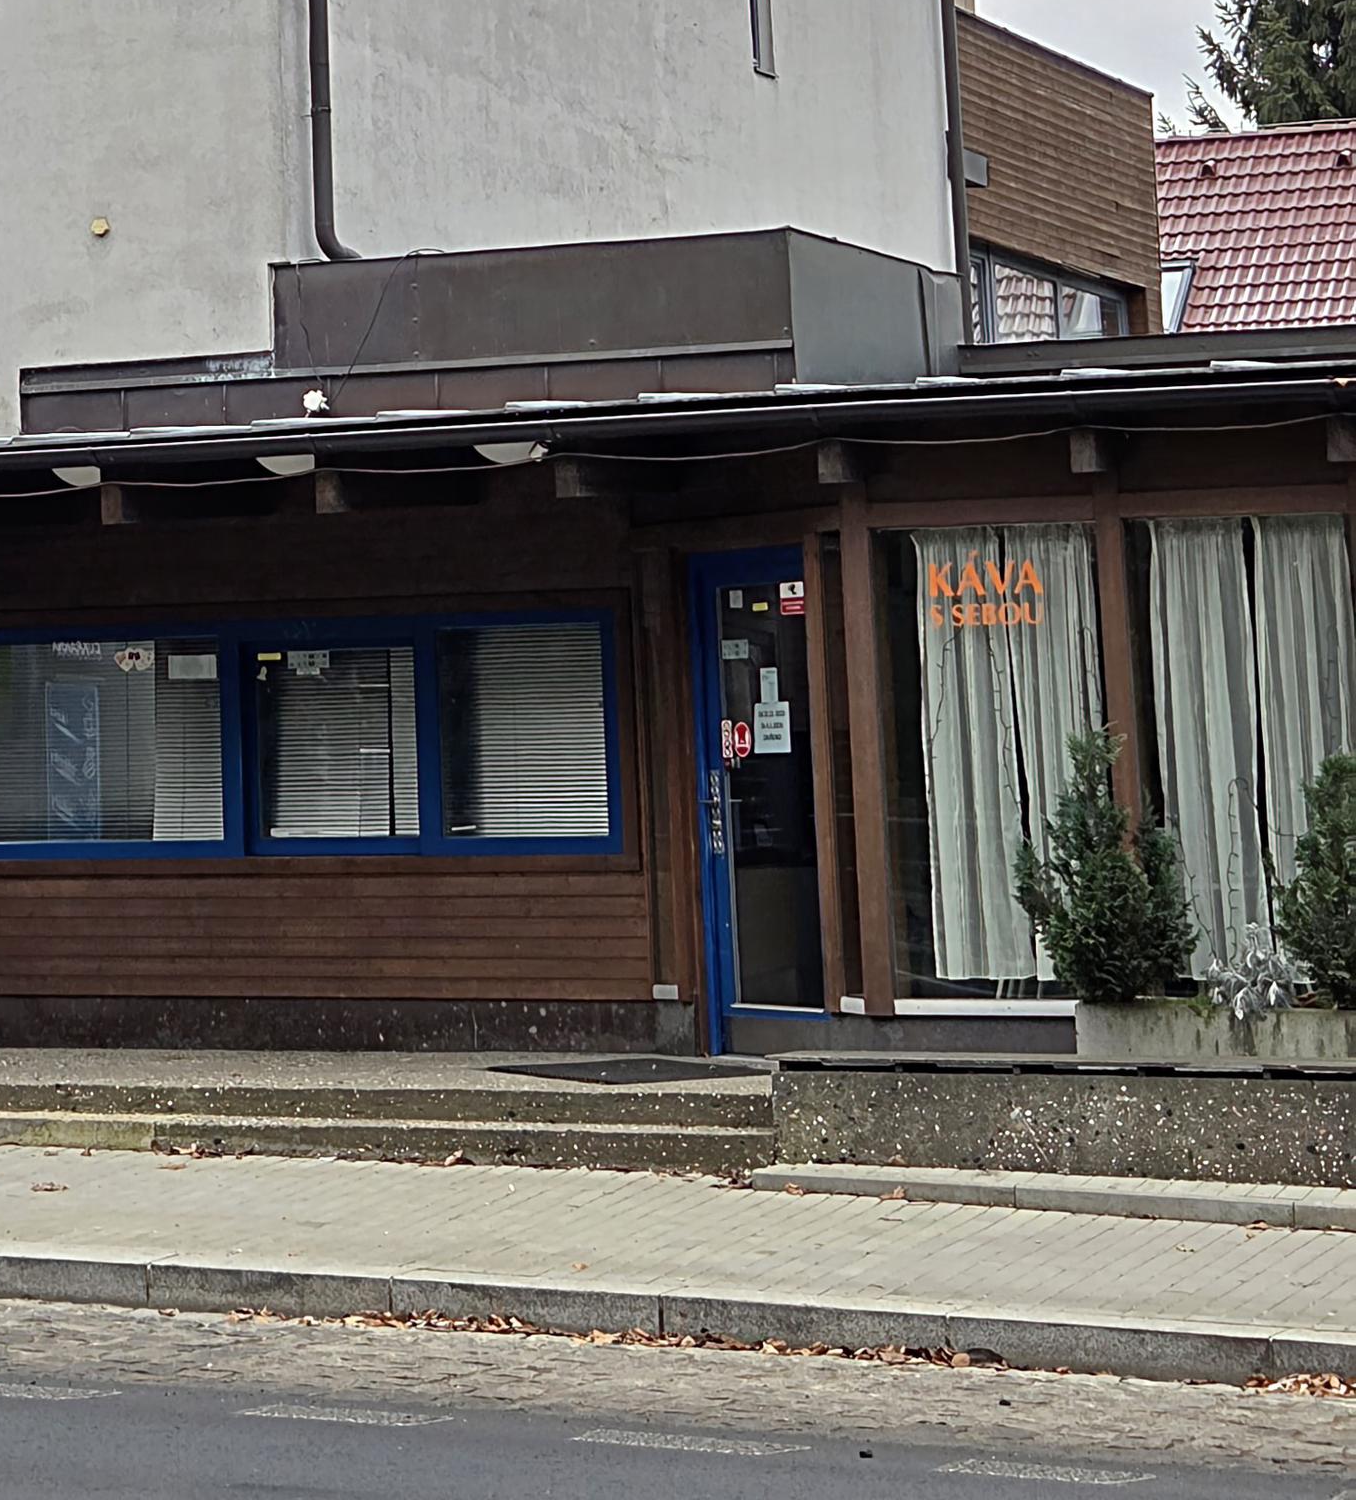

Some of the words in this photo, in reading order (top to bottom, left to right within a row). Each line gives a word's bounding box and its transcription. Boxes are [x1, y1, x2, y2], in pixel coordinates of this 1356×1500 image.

[928, 548, 1044, 597] KÁVA
[930, 603, 944, 629] S
[951, 601, 1044, 627] SEBOU
